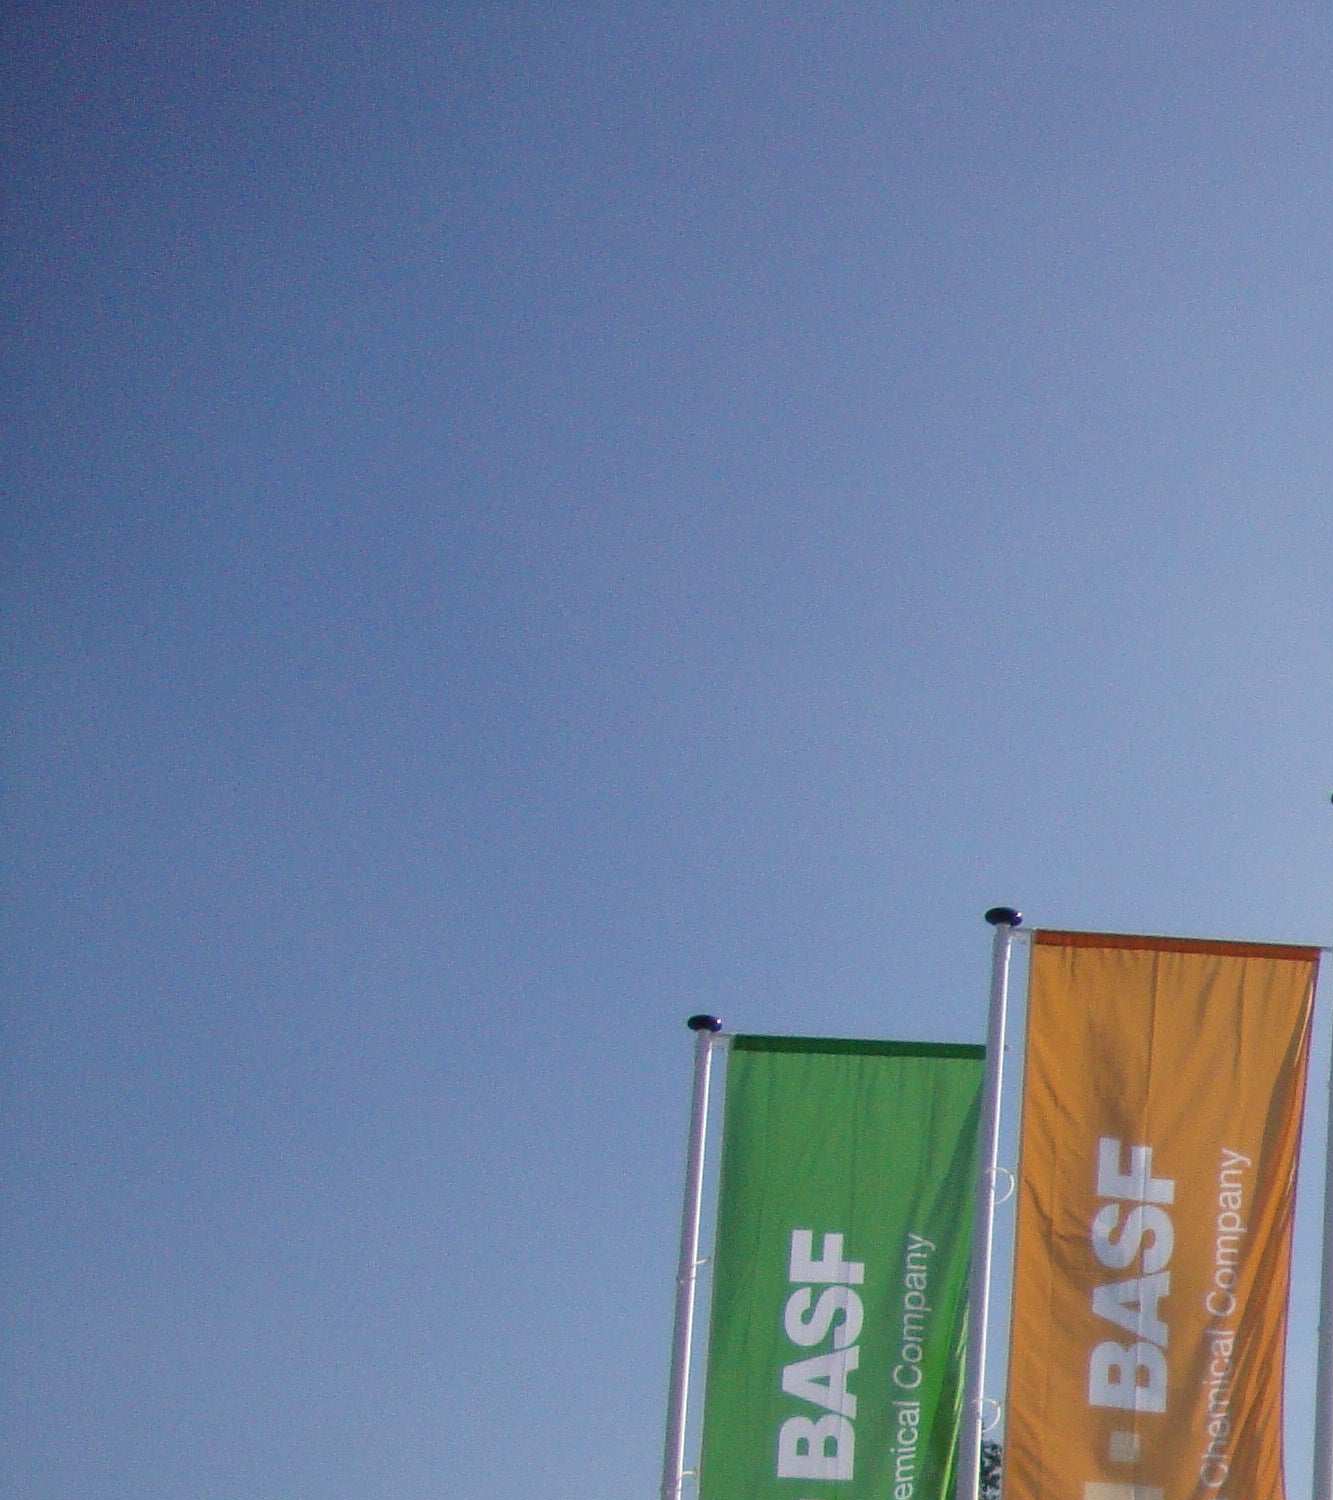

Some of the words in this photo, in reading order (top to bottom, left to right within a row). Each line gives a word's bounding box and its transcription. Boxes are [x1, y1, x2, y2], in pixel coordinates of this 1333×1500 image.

[893, 1233, 936, 1386] Company
[1088, 1137, 1175, 1413] BASF
[1206, 1148, 1252, 1317] Company
[777, 1229, 865, 1481] BASF
[1200, 1330, 1234, 1488] Chemical
